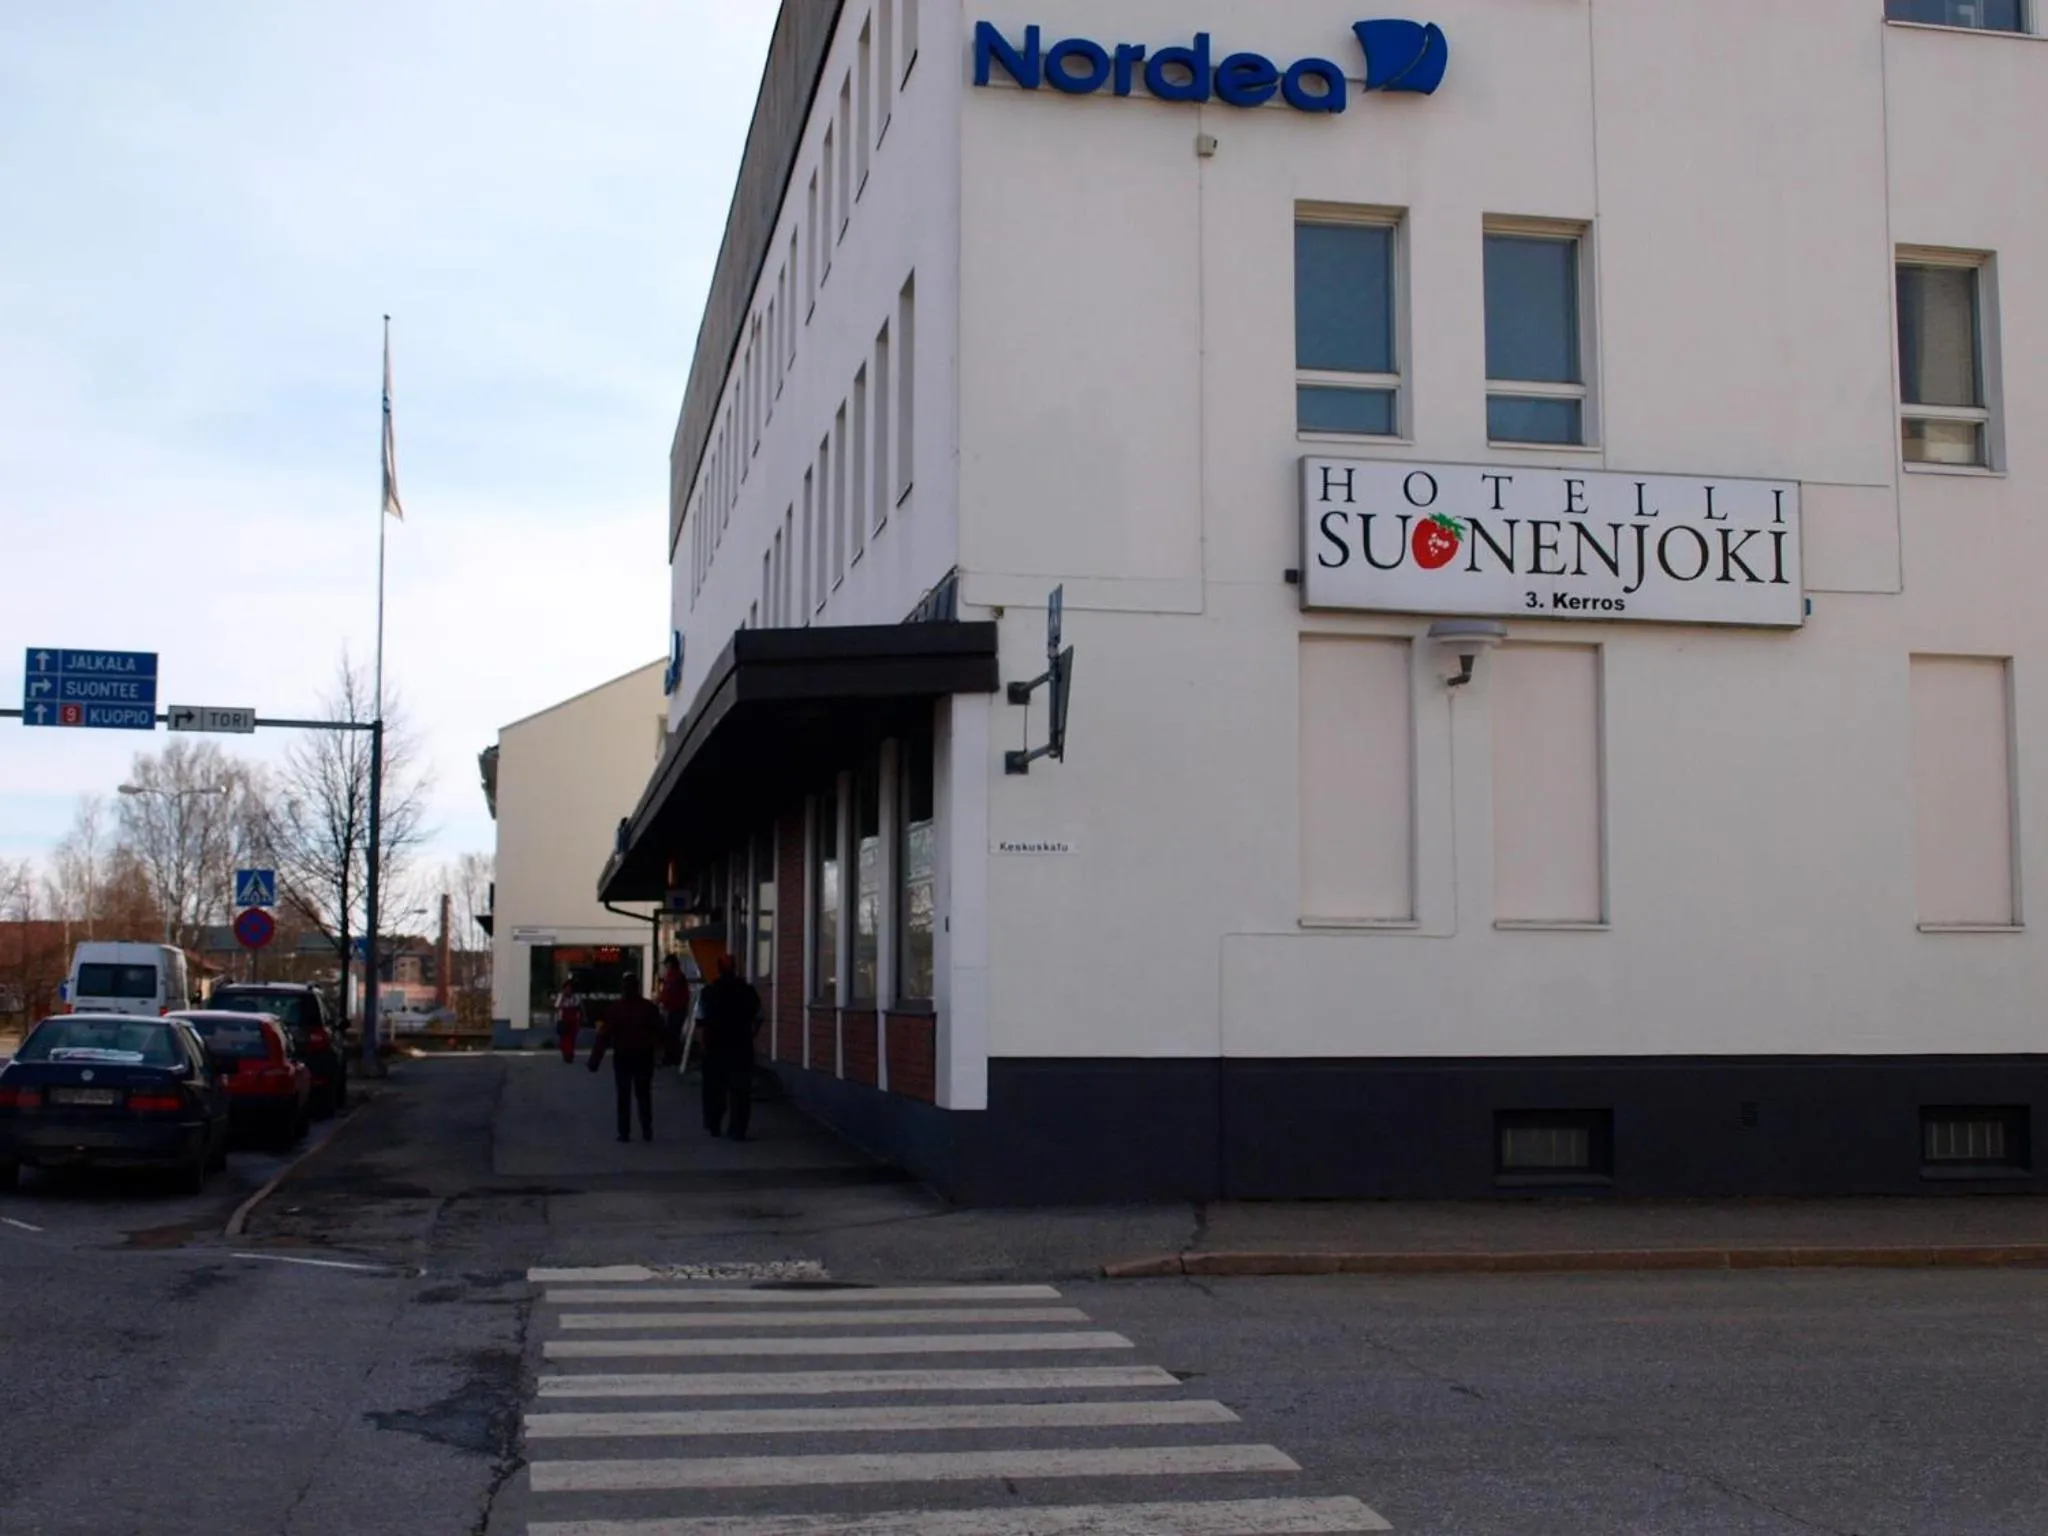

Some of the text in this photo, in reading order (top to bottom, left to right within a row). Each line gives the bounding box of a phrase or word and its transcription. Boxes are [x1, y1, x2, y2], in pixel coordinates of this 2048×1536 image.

[974, 20, 1347, 113] Nordea
[1319, 466, 1785, 523] HOTELLI
[1525, 591, 1625, 611] 3. Kerros
[67, 655, 137, 672] JALKALA
[66, 680, 139, 699] SUONTEE
[65, 706, 150, 726] 9 KUOPIO
[209, 711, 249, 728] TORI
[999, 841, 1069, 852] Keskuskatu
